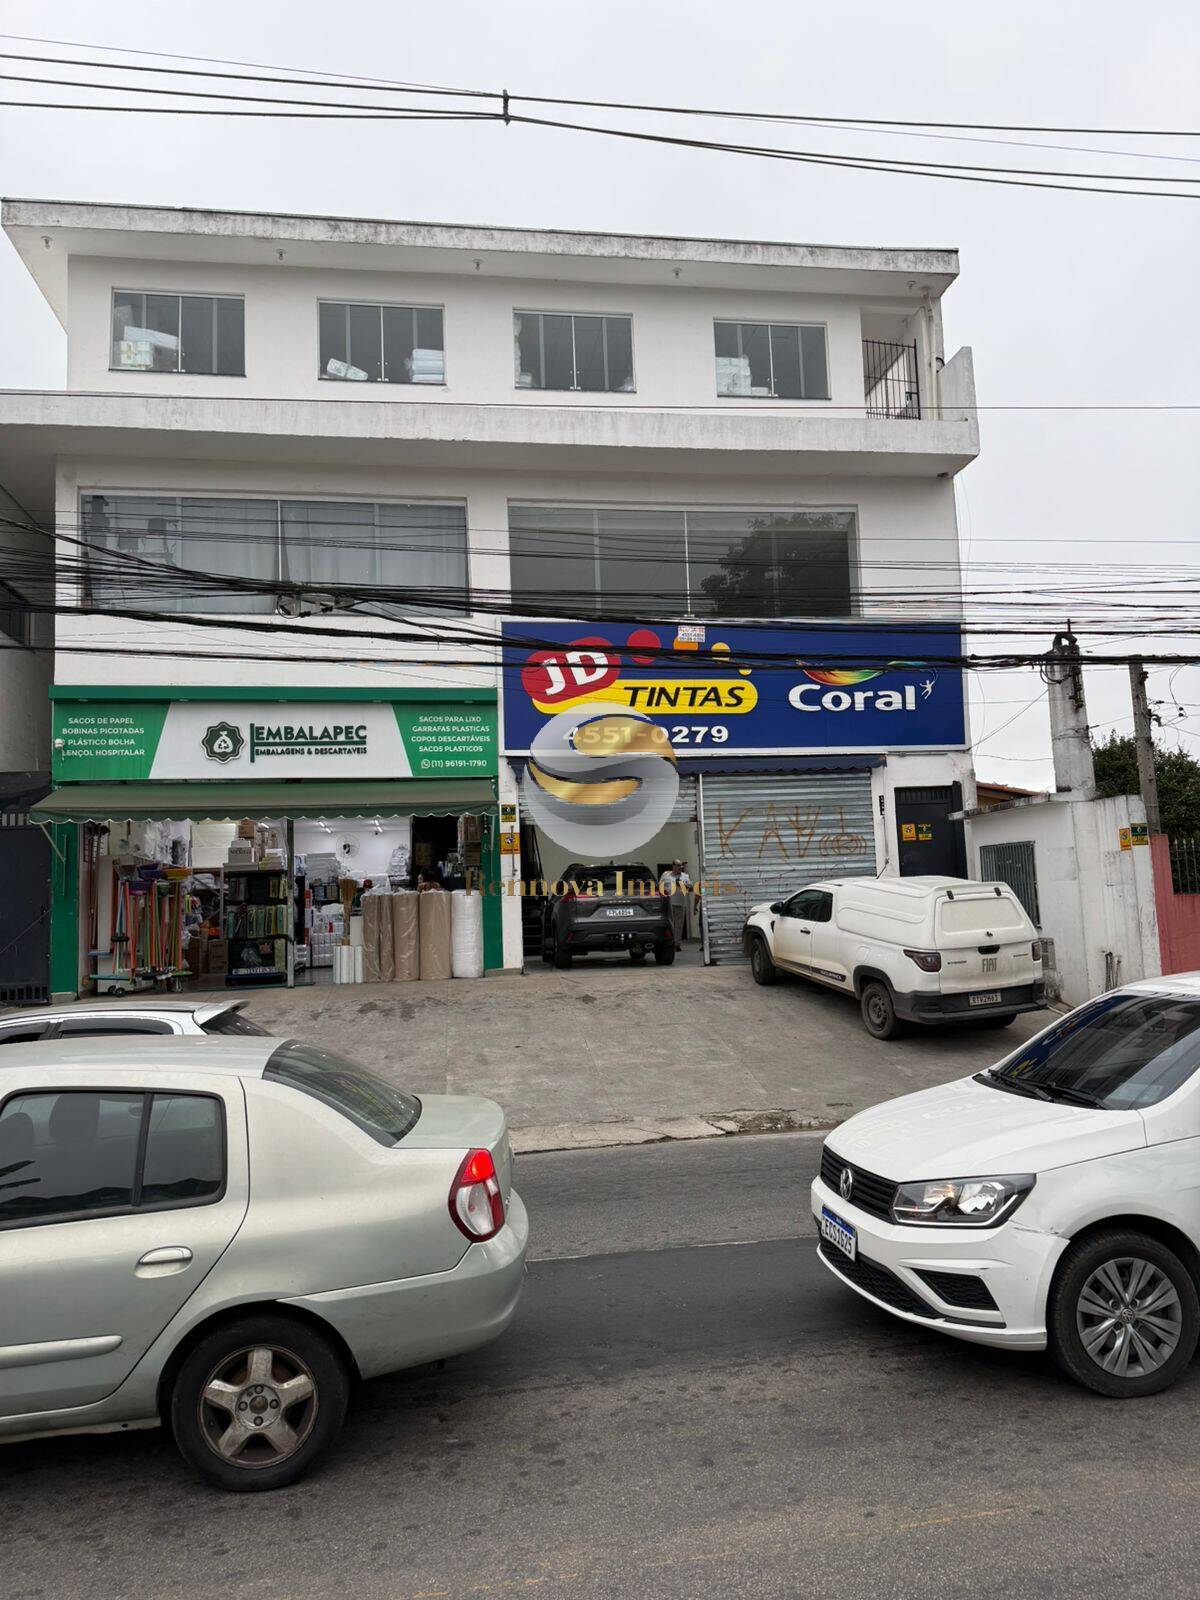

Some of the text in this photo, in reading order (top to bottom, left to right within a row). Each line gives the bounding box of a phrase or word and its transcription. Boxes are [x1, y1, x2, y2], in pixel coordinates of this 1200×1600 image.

[542, 650, 609, 696] JD
[623, 686, 746, 708] TINTAS
[788, 683, 916, 712] Coral
[68, 717, 135, 725] SACOS DE PAPEL
[418, 715, 482, 723] SACOS PARA LIXO
[62, 727, 145, 735] BOBINAS PICOTADAS
[255, 724, 368, 741] EMBALAPEC
[562, 725, 729, 744] 4551-0279
[68, 737, 136, 746] PLÁSTICO BOLHA
[437, 734, 491, 742] DESCARTÁVEIS
[62, 748, 145, 758] LENÇOL HOSPITALAR
[255, 747, 305, 756] EMBALAGENS
[431, 759, 488, 768] (11) 96191-1790
[981, 957, 998, 973] FIAT
